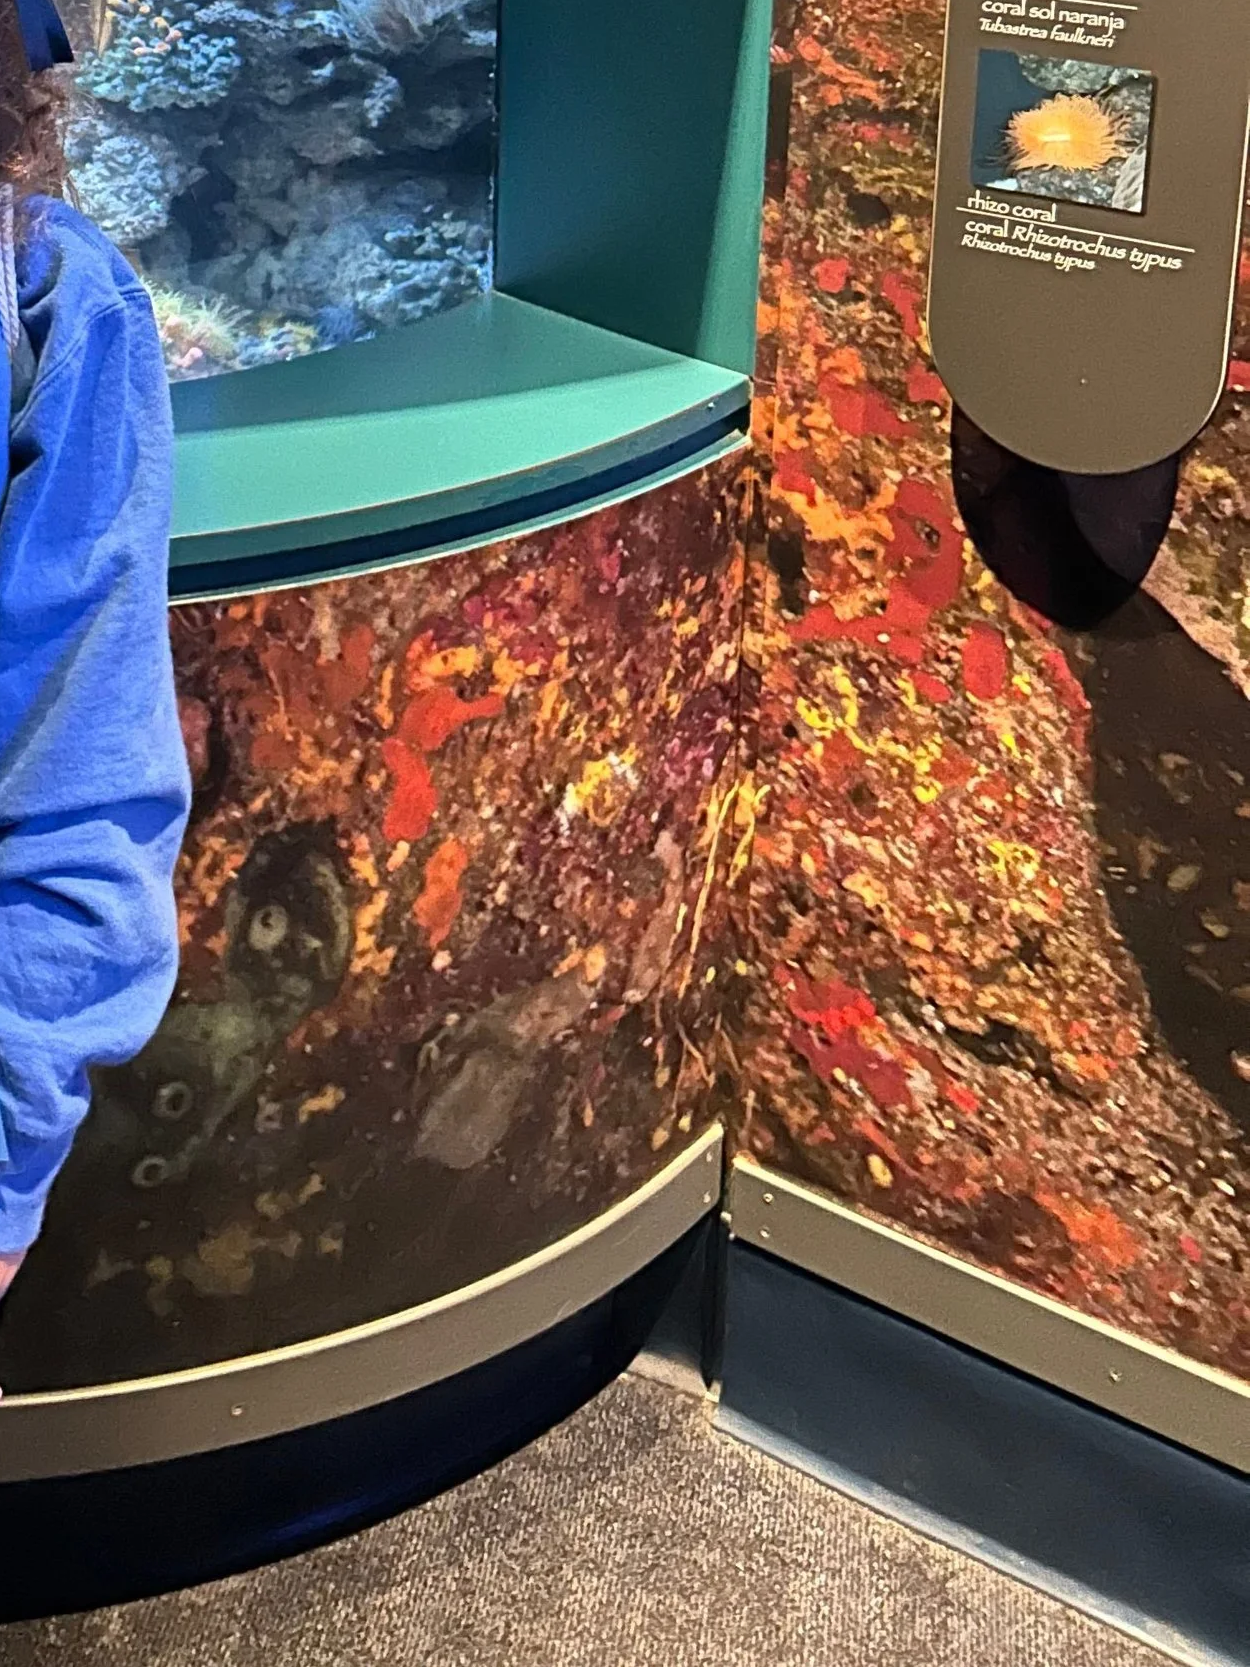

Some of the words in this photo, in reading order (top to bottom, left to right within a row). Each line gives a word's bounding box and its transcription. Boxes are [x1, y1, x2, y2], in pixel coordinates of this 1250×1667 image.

[978, 16, 1048, 39] Tubastrea
[1050, 24, 1117, 48] faulkneri
[1028, 0, 1056, 21] sol
[1058, 9, 1126, 38] naranja
[967, 189, 1010, 215] rhizo
[1011, 202, 1057, 223] coral
[961, 233, 1052, 262] Rhizotrochus
[1053, 252, 1096, 272] typus
[964, 219, 1009, 238] coral
[1012, 223, 1127, 260] Rhizotrochus
[1129, 246, 1183, 273] typus
